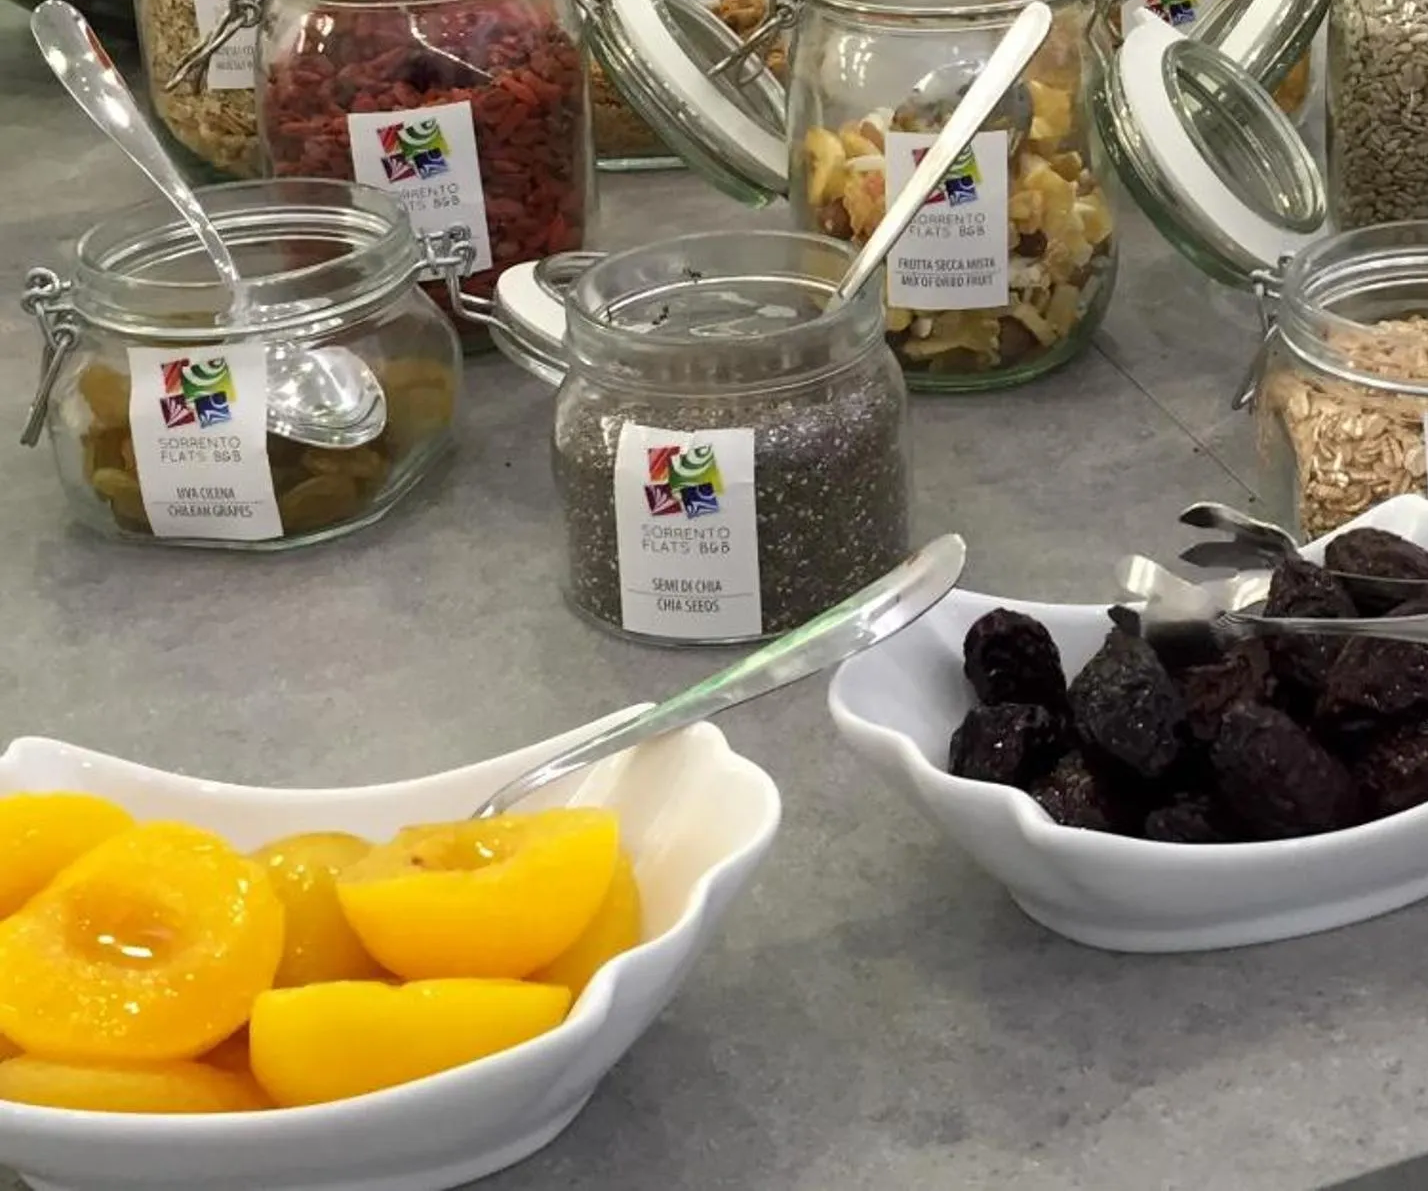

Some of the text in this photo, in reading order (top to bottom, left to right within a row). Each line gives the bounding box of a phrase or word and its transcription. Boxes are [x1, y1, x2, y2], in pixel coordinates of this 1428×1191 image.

[898, 257, 933, 270] FRUTTA
[935, 258, 964, 271] SECCA
[901, 274, 920, 287] MIX
[966, 274, 993, 287] FRUIT
[158, 436, 242, 450] SORRENTO
[160, 449, 208, 463] FLATS
[176, 487, 198, 500] UVA
[212, 505, 254, 518] GRAPES
[640, 524, 731, 541] SORRENTO
[642, 539, 691, 555] FLATS
[651, 577, 723, 593] SEMI DI CHIA
[656, 598, 720, 614] CHIA SEEDS
